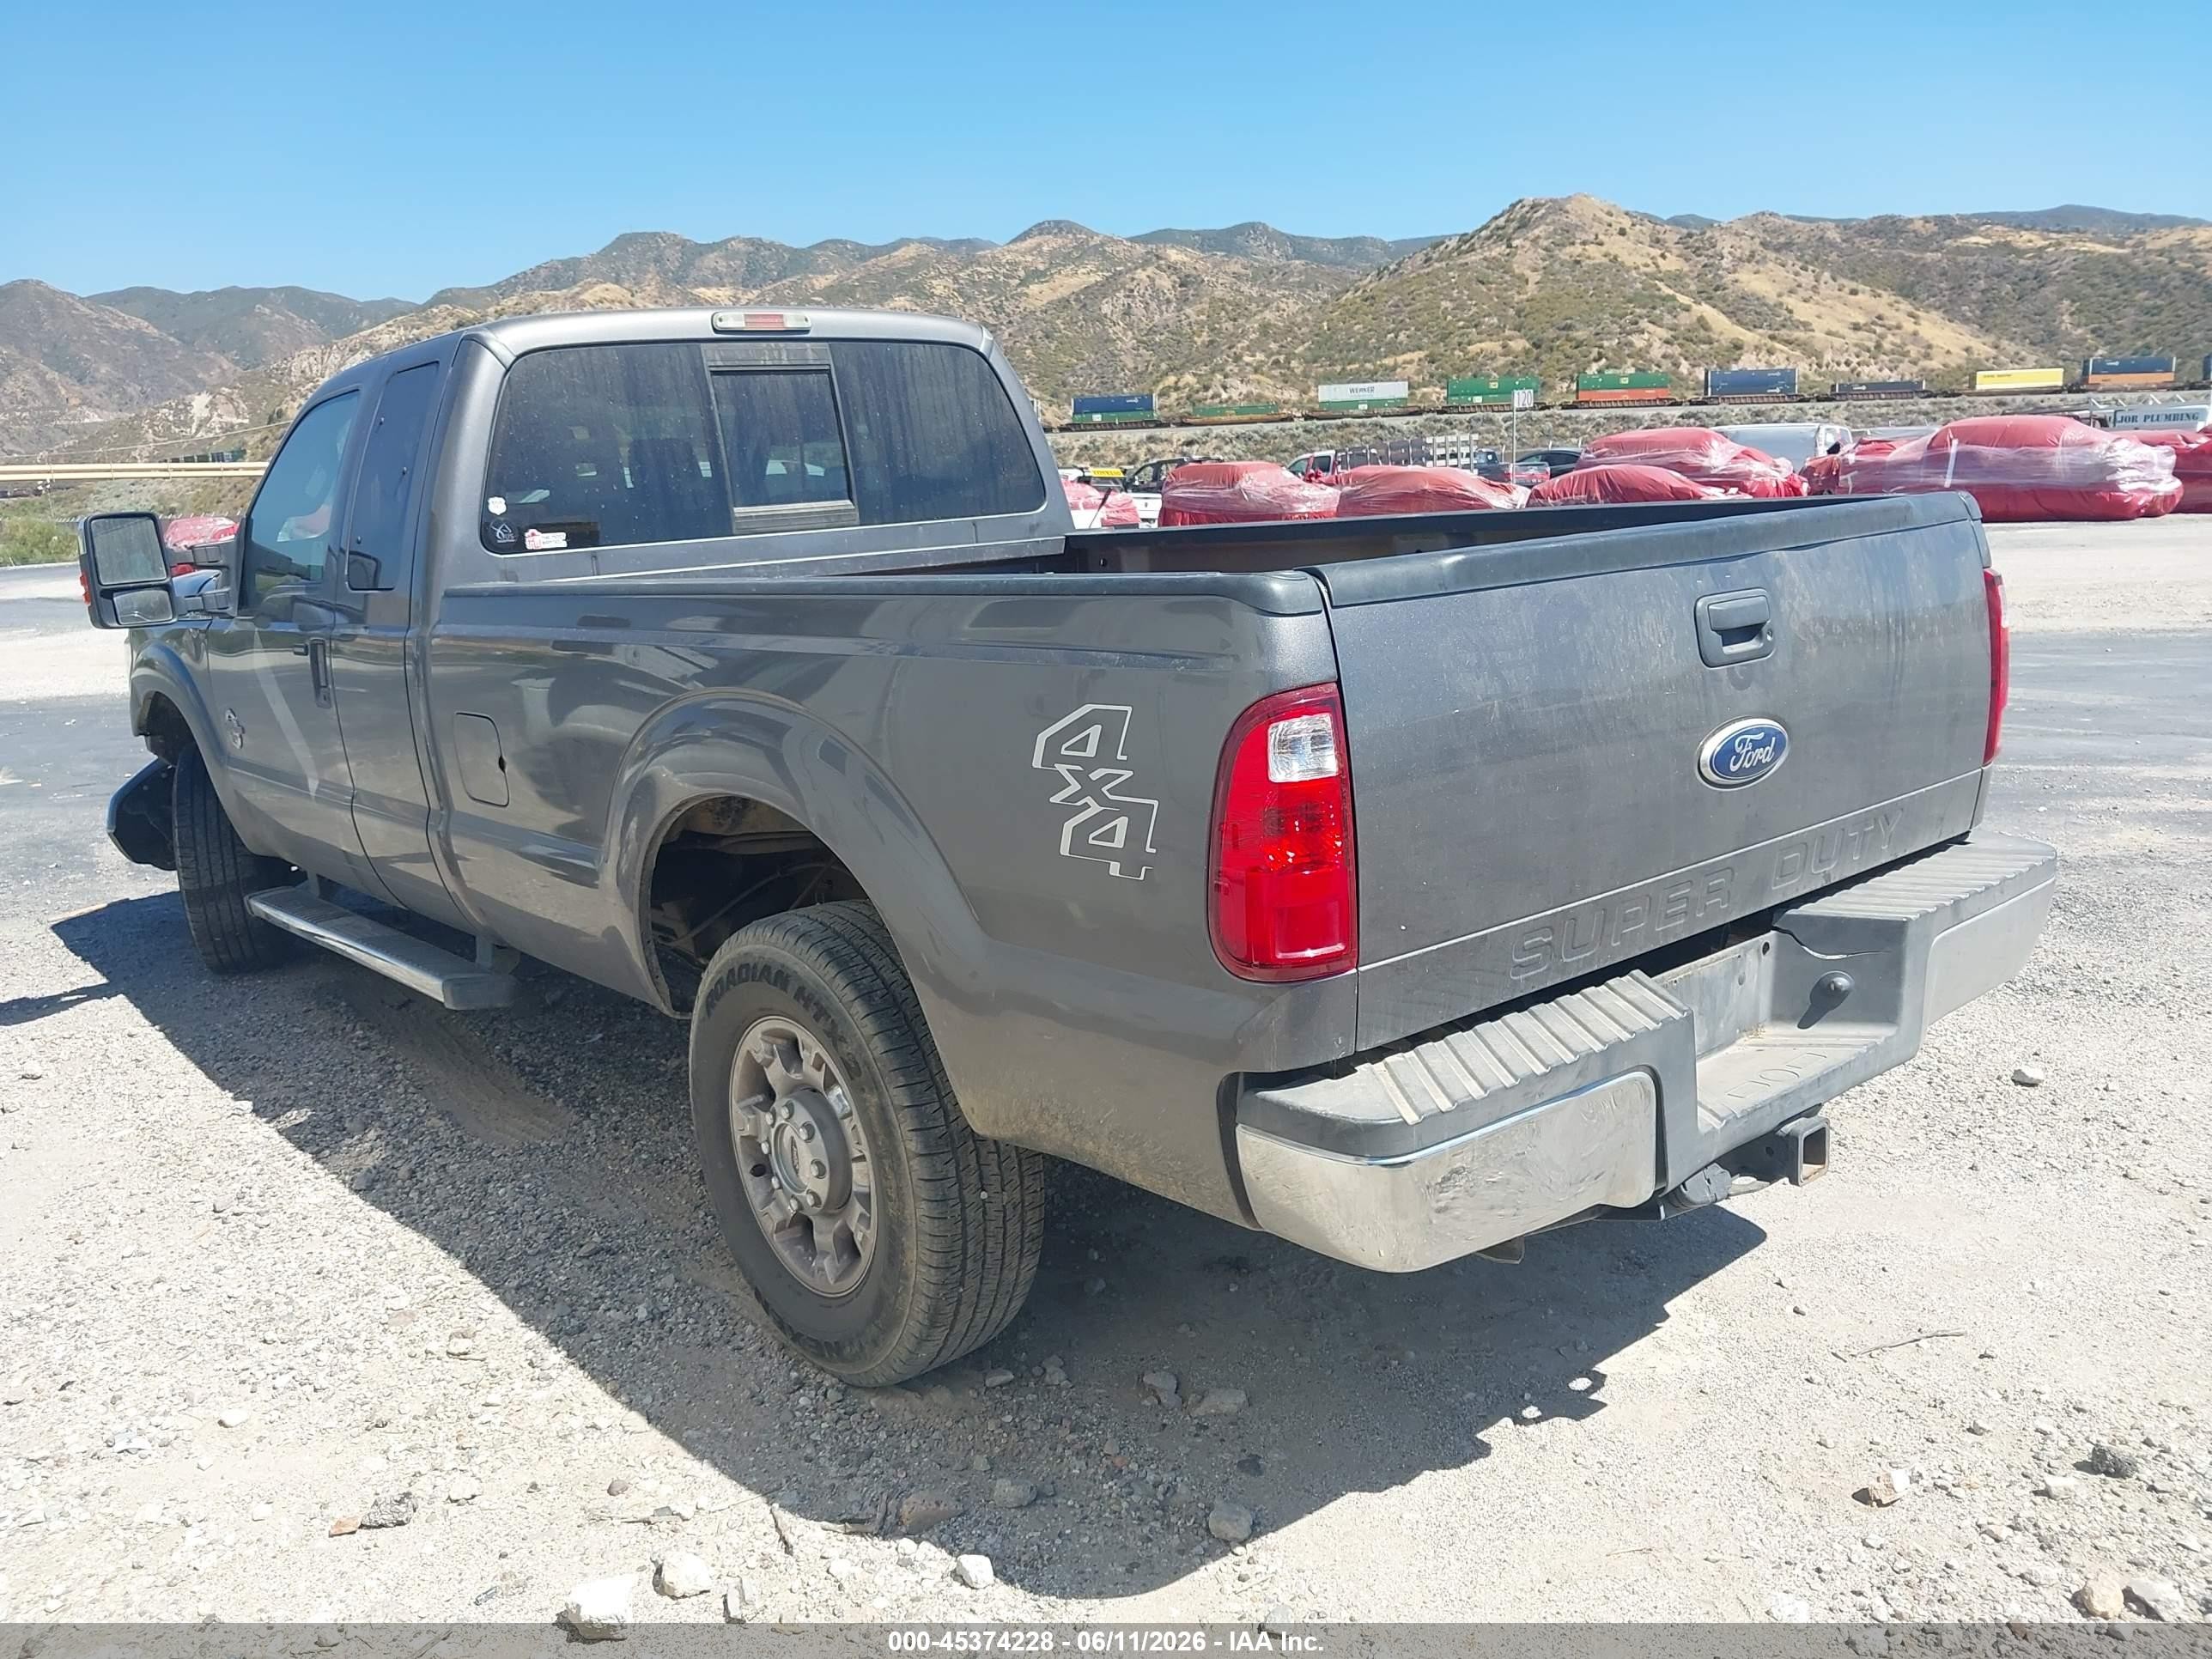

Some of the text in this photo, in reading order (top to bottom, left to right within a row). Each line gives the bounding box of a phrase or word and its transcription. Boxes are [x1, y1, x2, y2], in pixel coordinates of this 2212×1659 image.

[1516, 391, 1533, 406] 120
[2143, 412, 2199, 422] PLUMBING
[1729, 732, 1777, 772] Ford
[1509, 806, 1905, 981] SUPER DUTY
